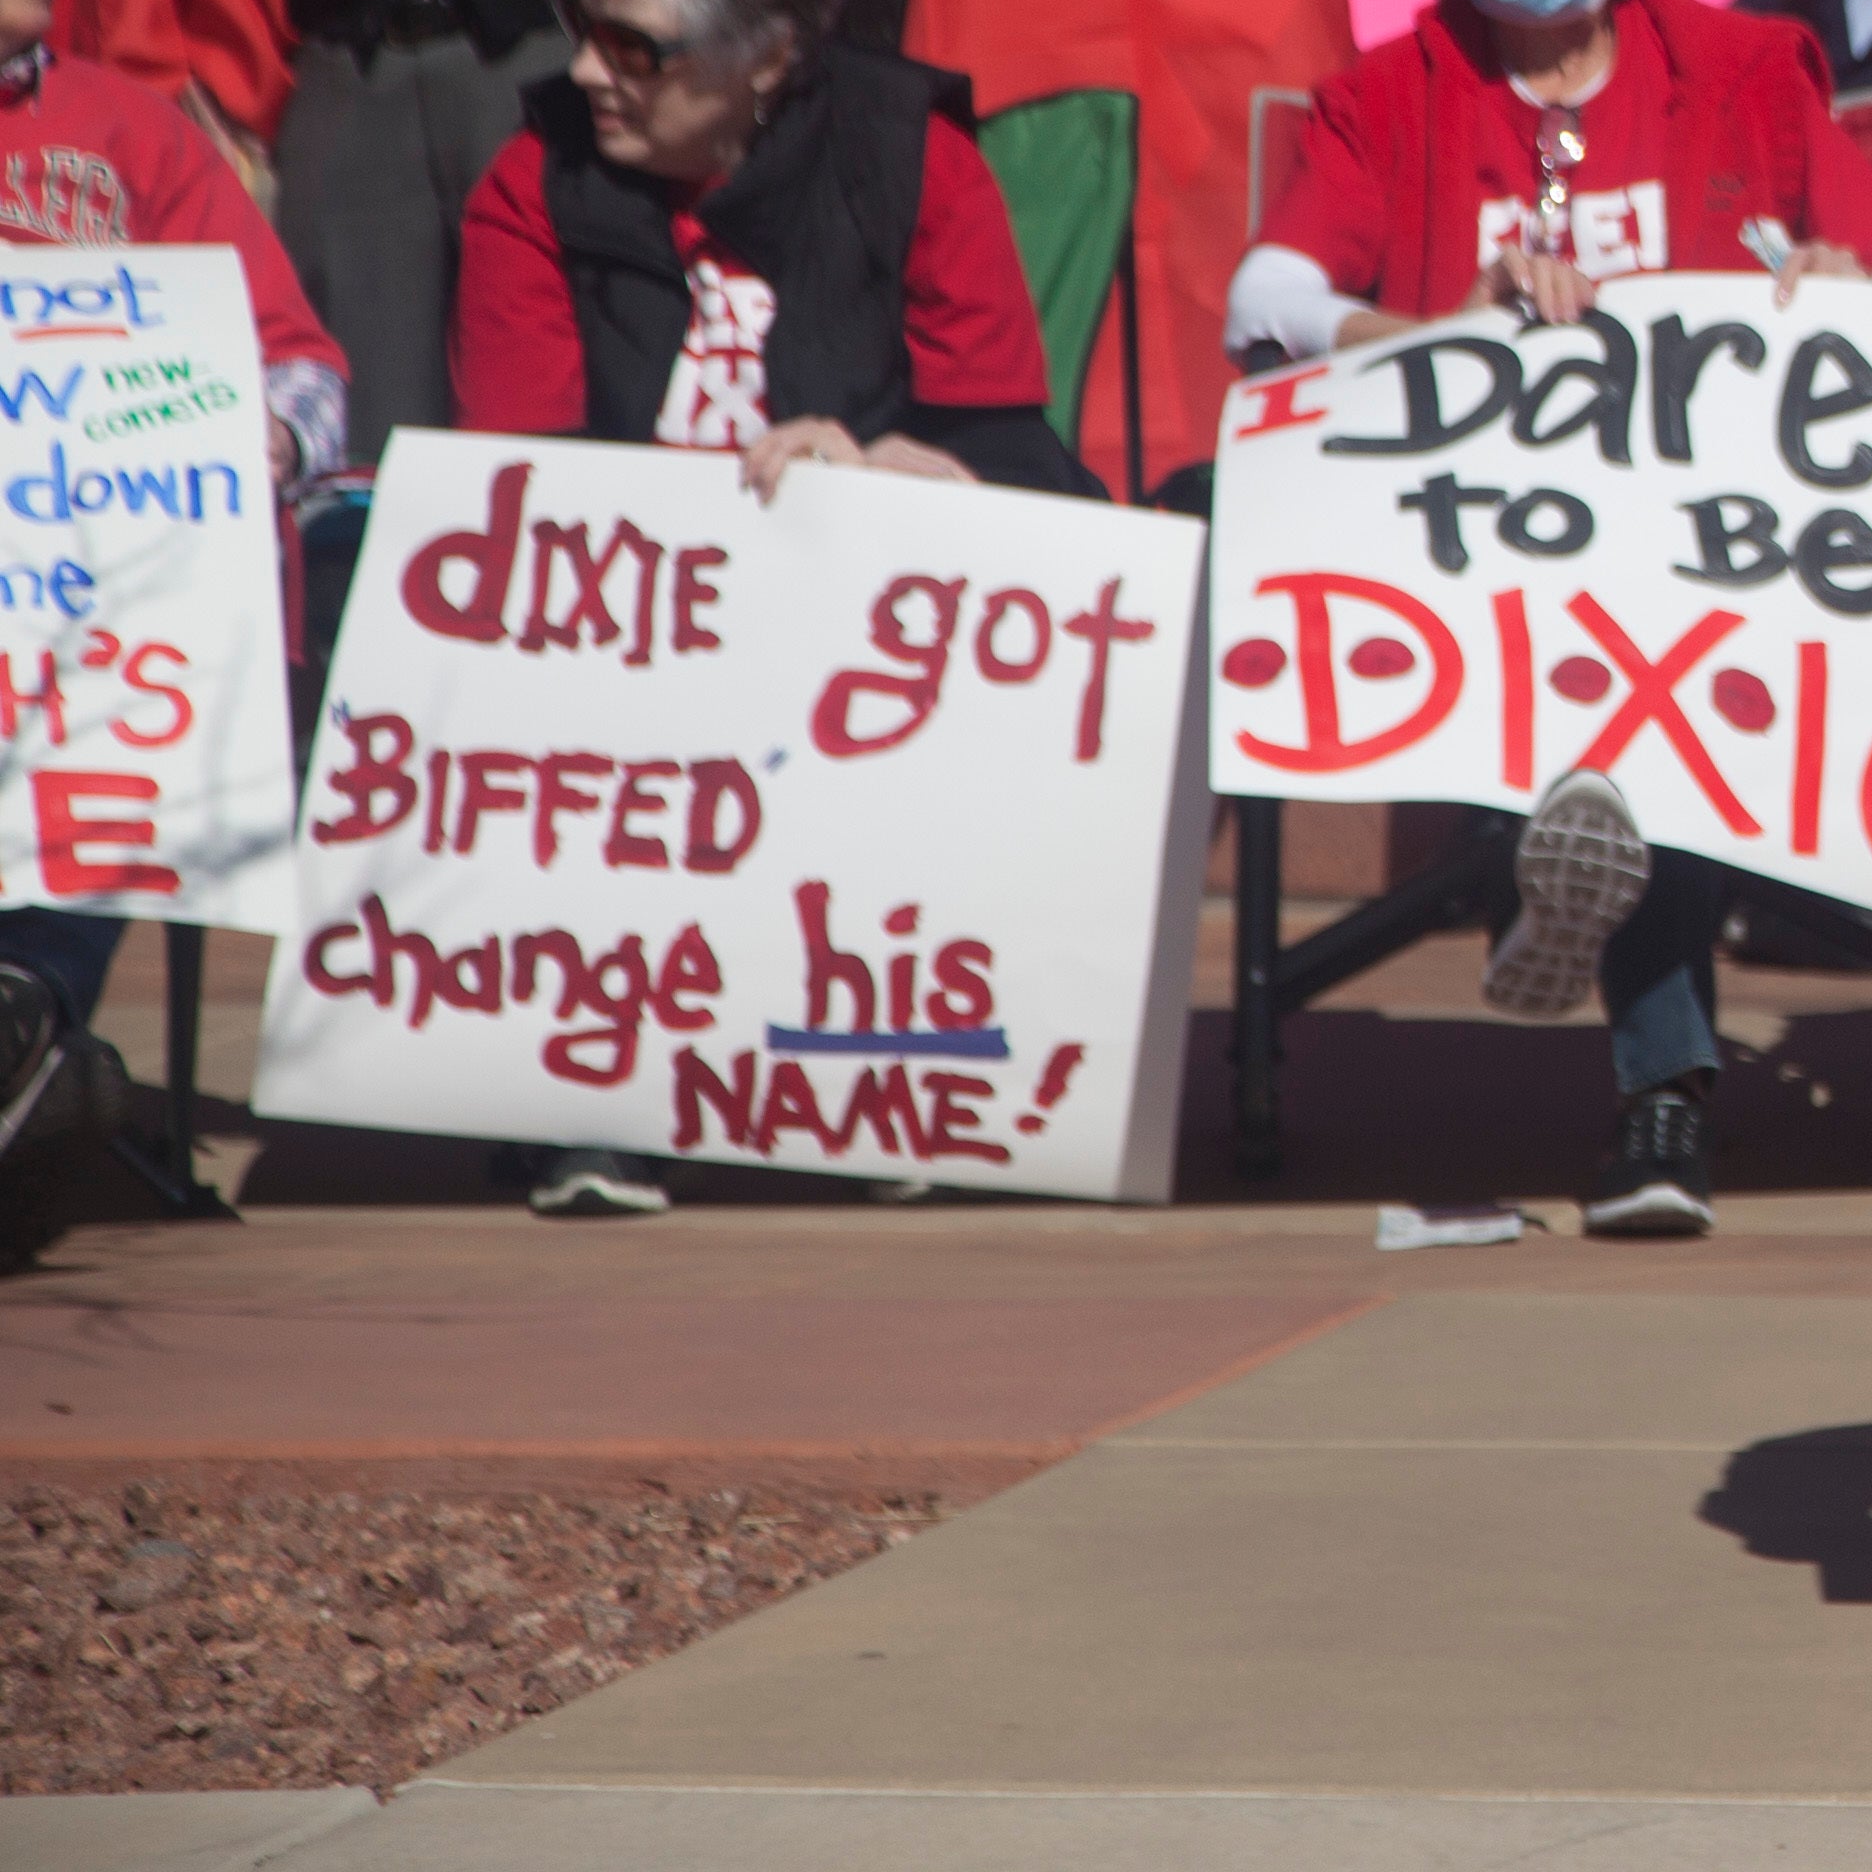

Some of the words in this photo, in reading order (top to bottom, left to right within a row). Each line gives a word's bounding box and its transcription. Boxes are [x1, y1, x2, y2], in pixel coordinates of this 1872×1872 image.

[1234, 365, 1331, 440] I
[5, 436, 242, 524] down
[1398, 471, 1596, 576] to
[809, 572, 1157, 763] got
[303, 892, 724, 1088] change
[796, 878, 998, 1034] his
[670, 1040, 1088, 1168] NAME!
